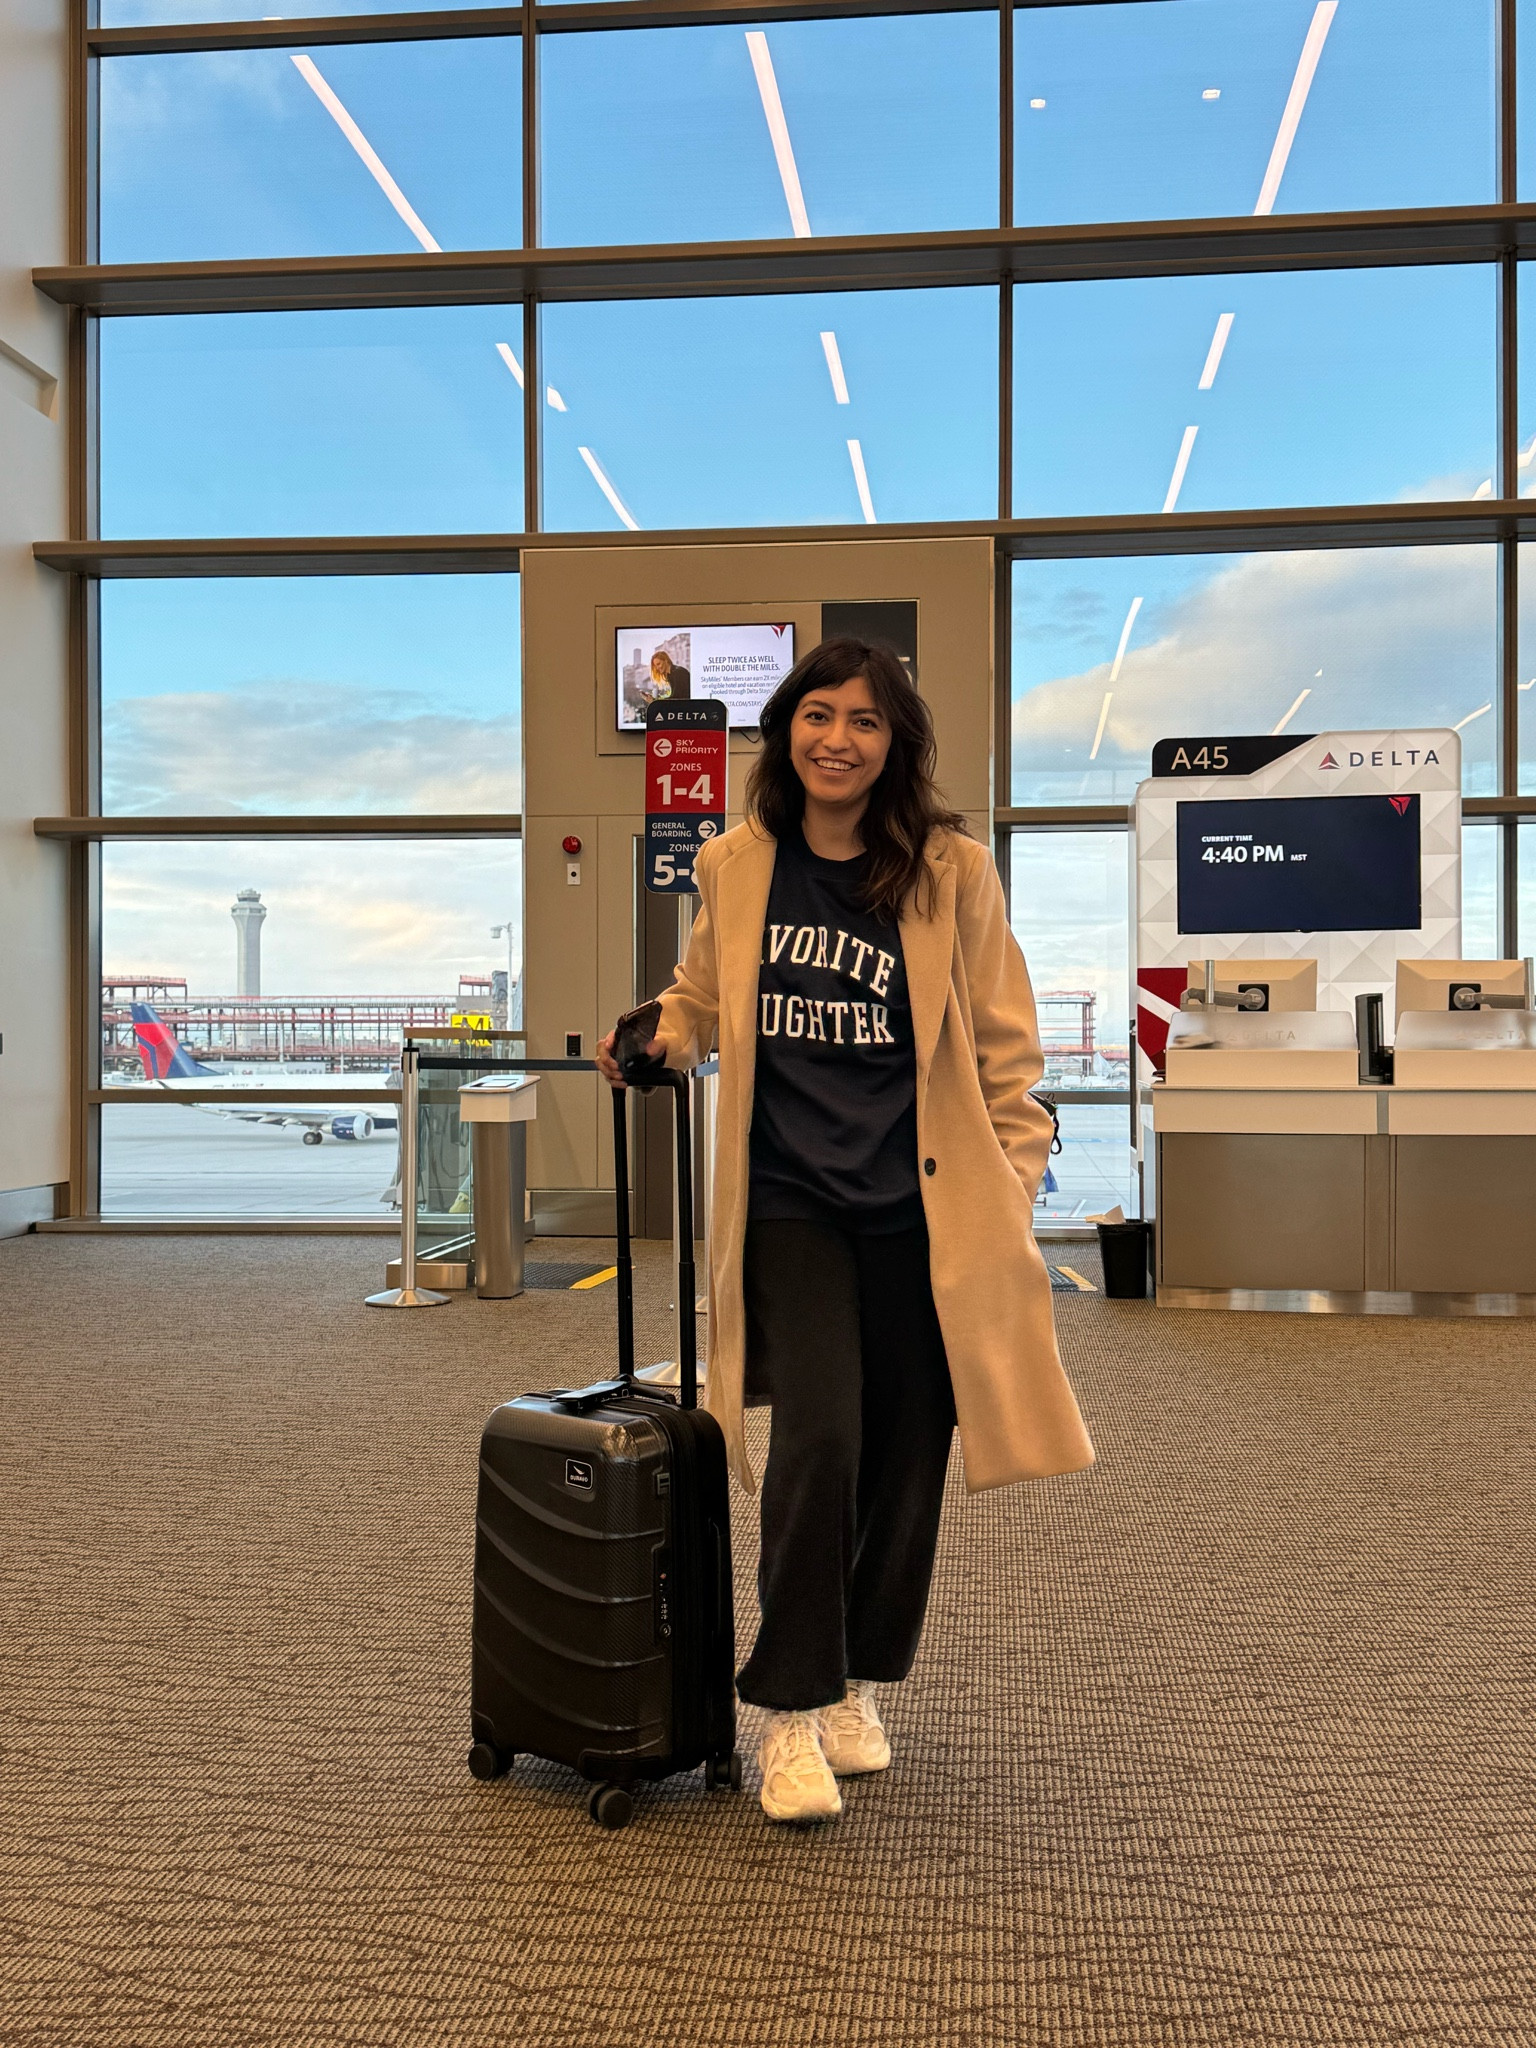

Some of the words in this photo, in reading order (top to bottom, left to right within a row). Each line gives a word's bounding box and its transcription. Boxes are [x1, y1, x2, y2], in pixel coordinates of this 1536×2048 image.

[708, 656, 727, 664] SLEEP
[727, 656, 747, 664] TWICE
[757, 655, 775, 663] WELL
[721, 664, 746, 672] DOUBLE
[760, 663, 781, 671] MILES.
[667, 712, 707, 721] DELTA
[675, 747, 718, 755] PRIORITY
[1171, 746, 1229, 771] A45
[1349, 749, 1440, 767] DELTA
[670, 763, 702, 772] ZONES
[656, 774, 714, 806] 1-4
[652, 822, 686, 830] GENERAL
[651, 830, 692, 838] BOARDING
[668, 843, 700, 852] ZONES
[1201, 846, 1248, 864] 4:40
[1252, 845, 1284, 863] PM
[1290, 853, 1308, 862] MST
[769, 925, 896, 998] VORITE
[760, 993, 895, 1044] UGHTER
